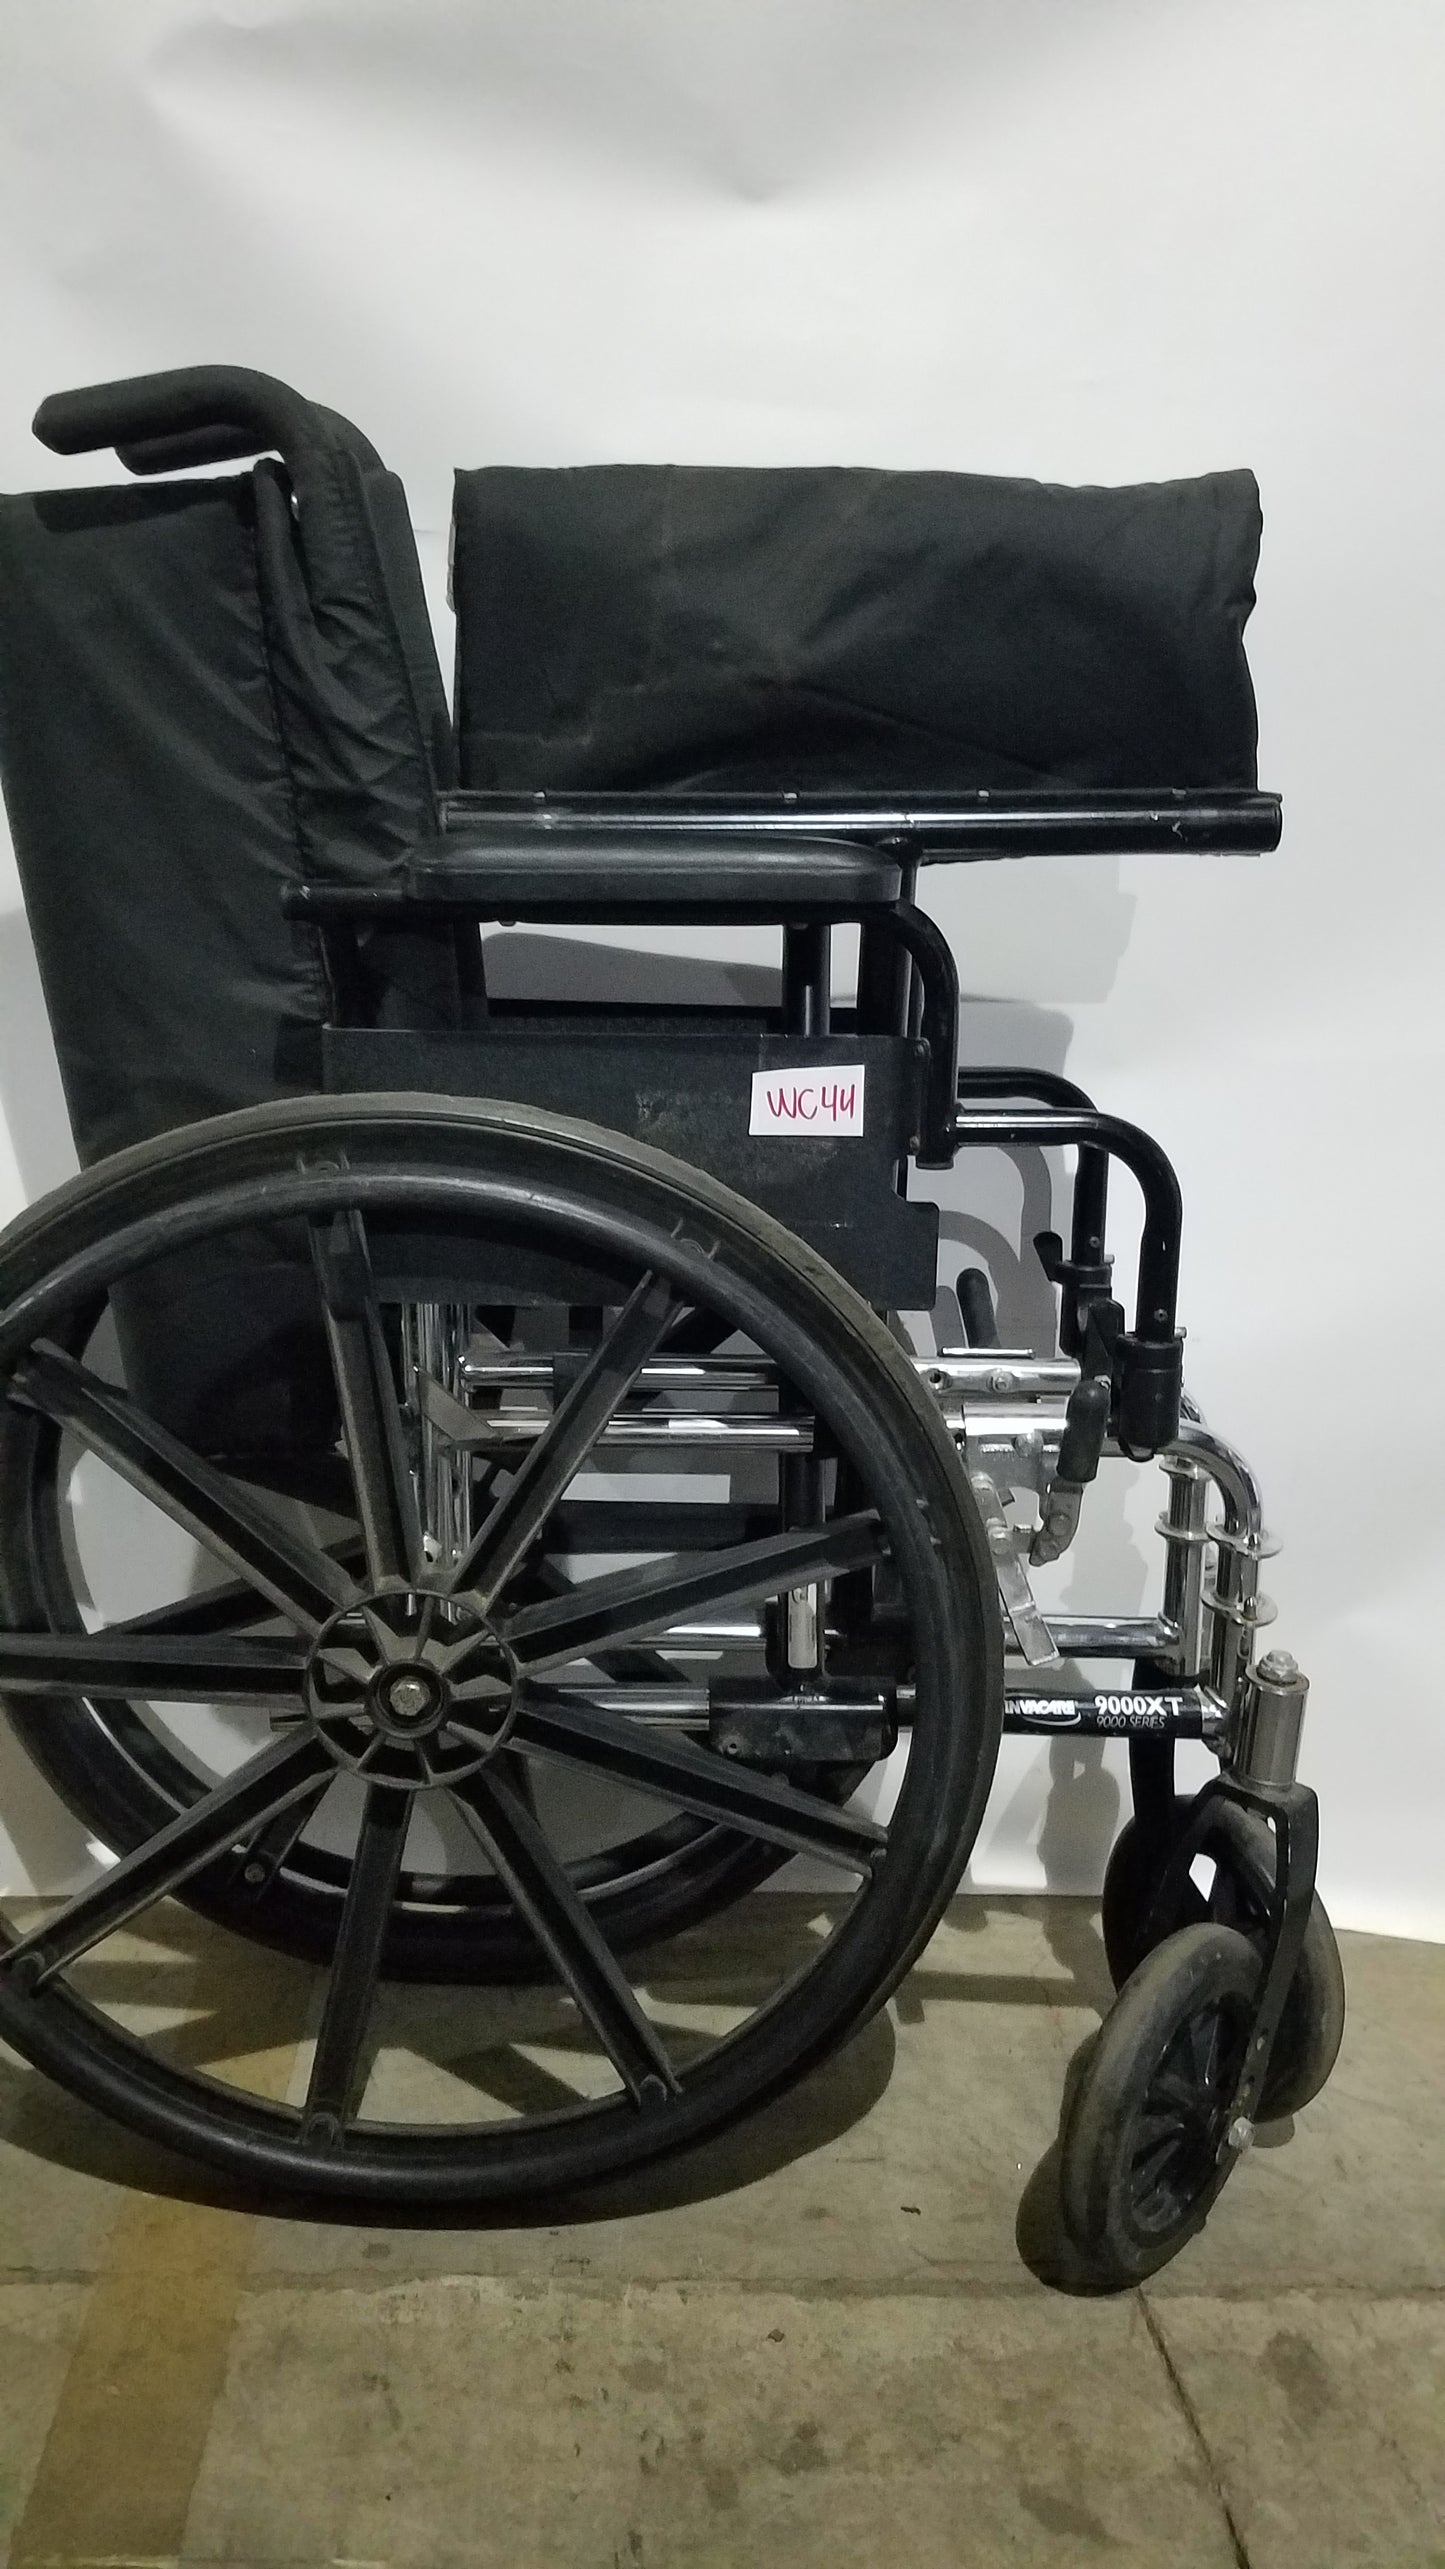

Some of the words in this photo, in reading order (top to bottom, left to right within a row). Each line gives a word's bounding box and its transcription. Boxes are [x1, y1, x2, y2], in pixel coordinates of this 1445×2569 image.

[766, 1084, 856, 1122] WC44
[1004, 1699, 1077, 1715] INVACARE
[1095, 1695, 1183, 1716] 9000XT
[1096, 1715, 1126, 1729] 9000
[1130, 1715, 1165, 1729] SERIES
